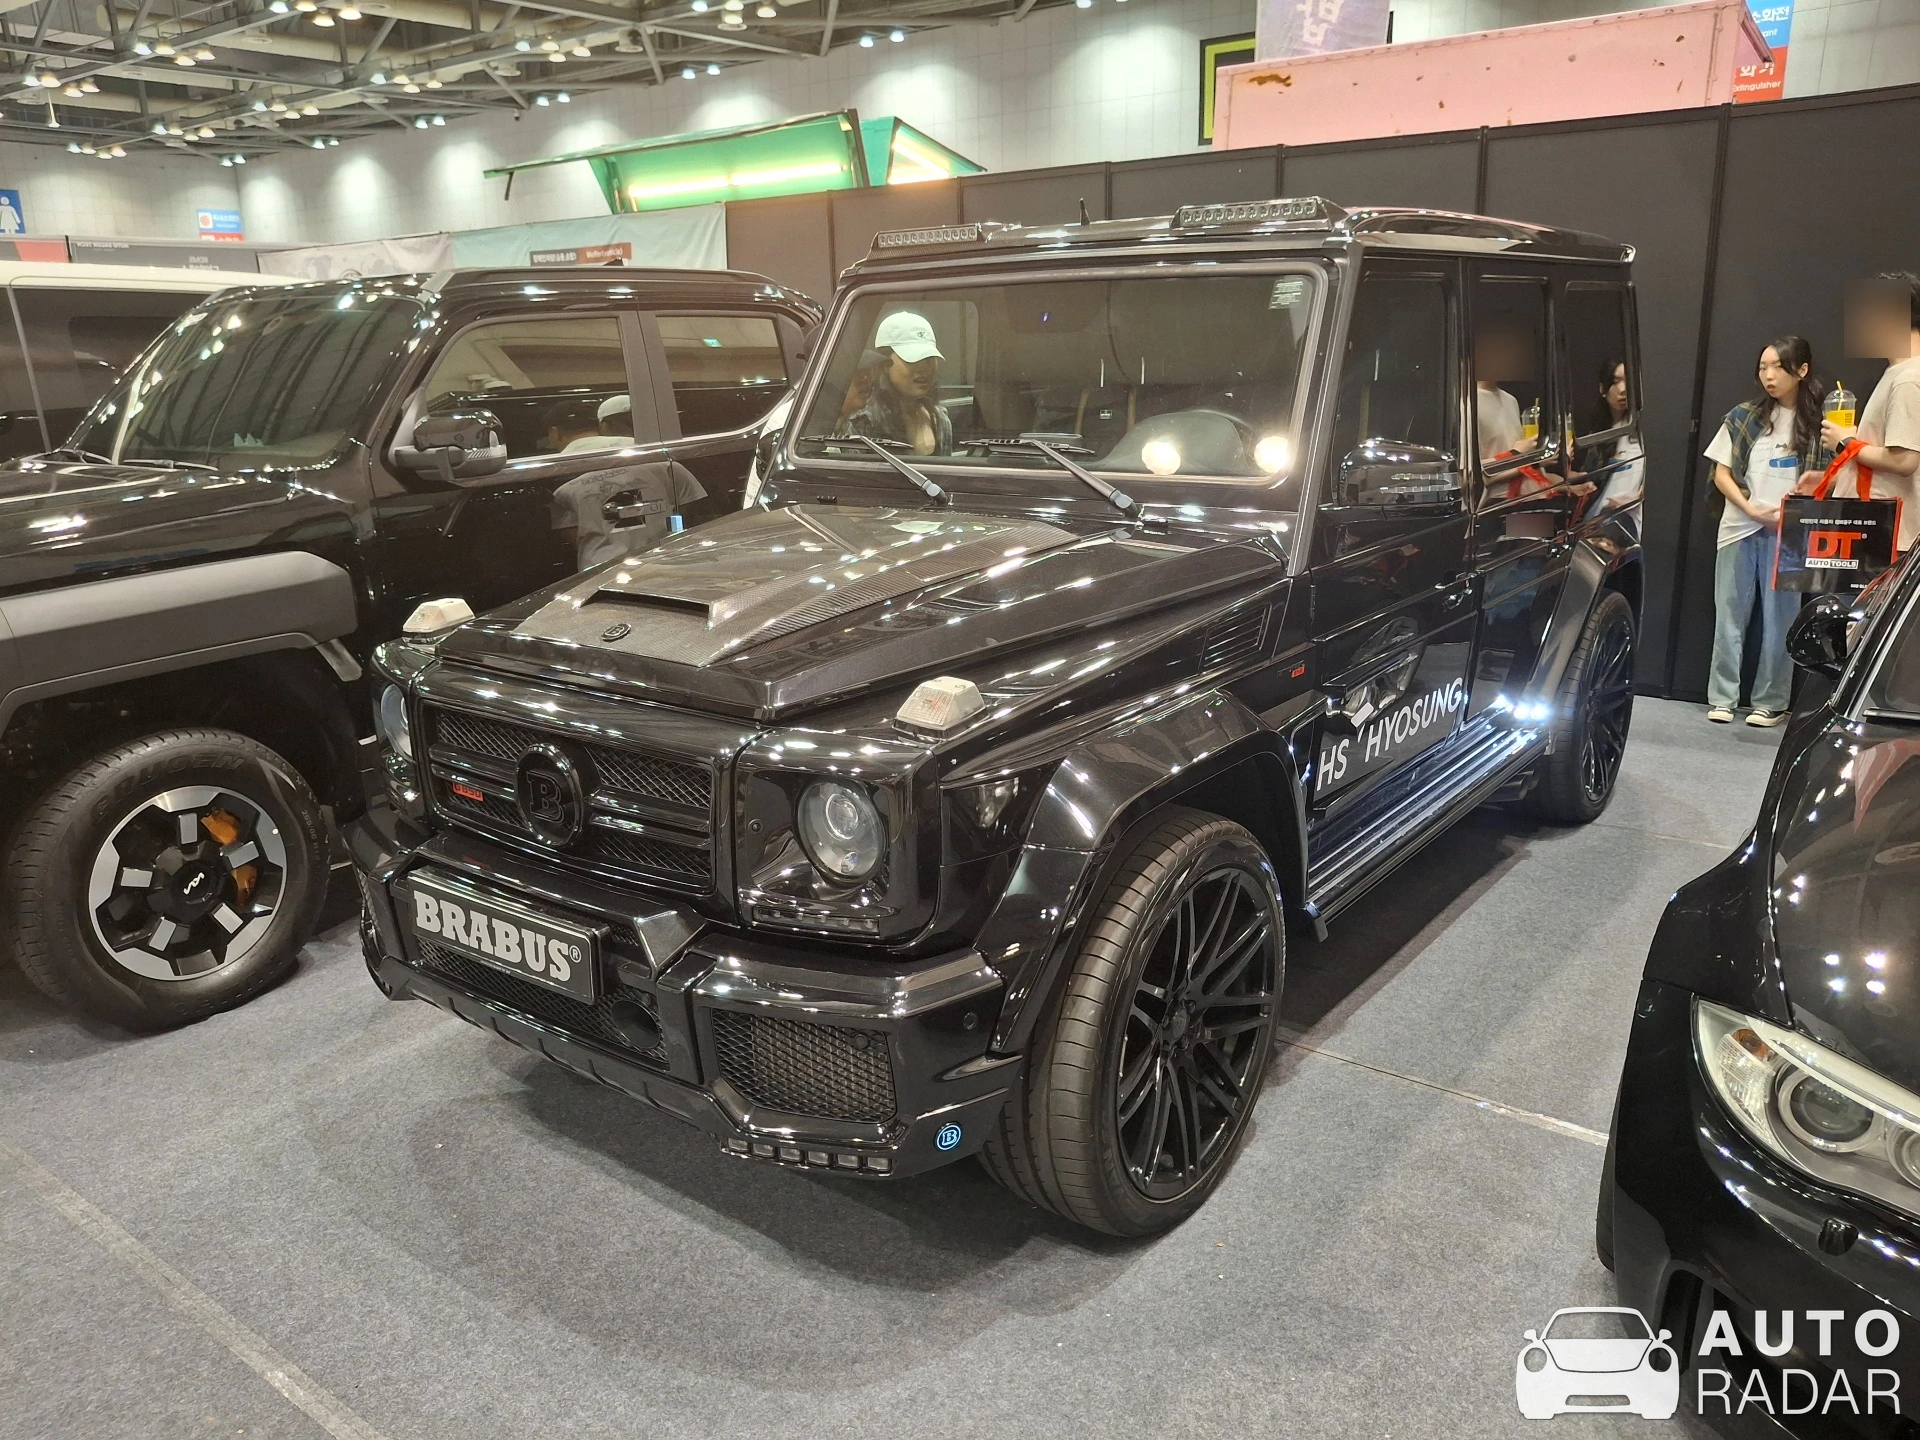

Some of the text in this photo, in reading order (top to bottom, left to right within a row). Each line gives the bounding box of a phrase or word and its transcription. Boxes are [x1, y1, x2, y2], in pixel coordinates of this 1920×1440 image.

[1807, 530, 1862, 560] DT
[1831, 560, 1857, 568] TOOLS
[1316, 677, 1463, 792] HS HYOSUNG
